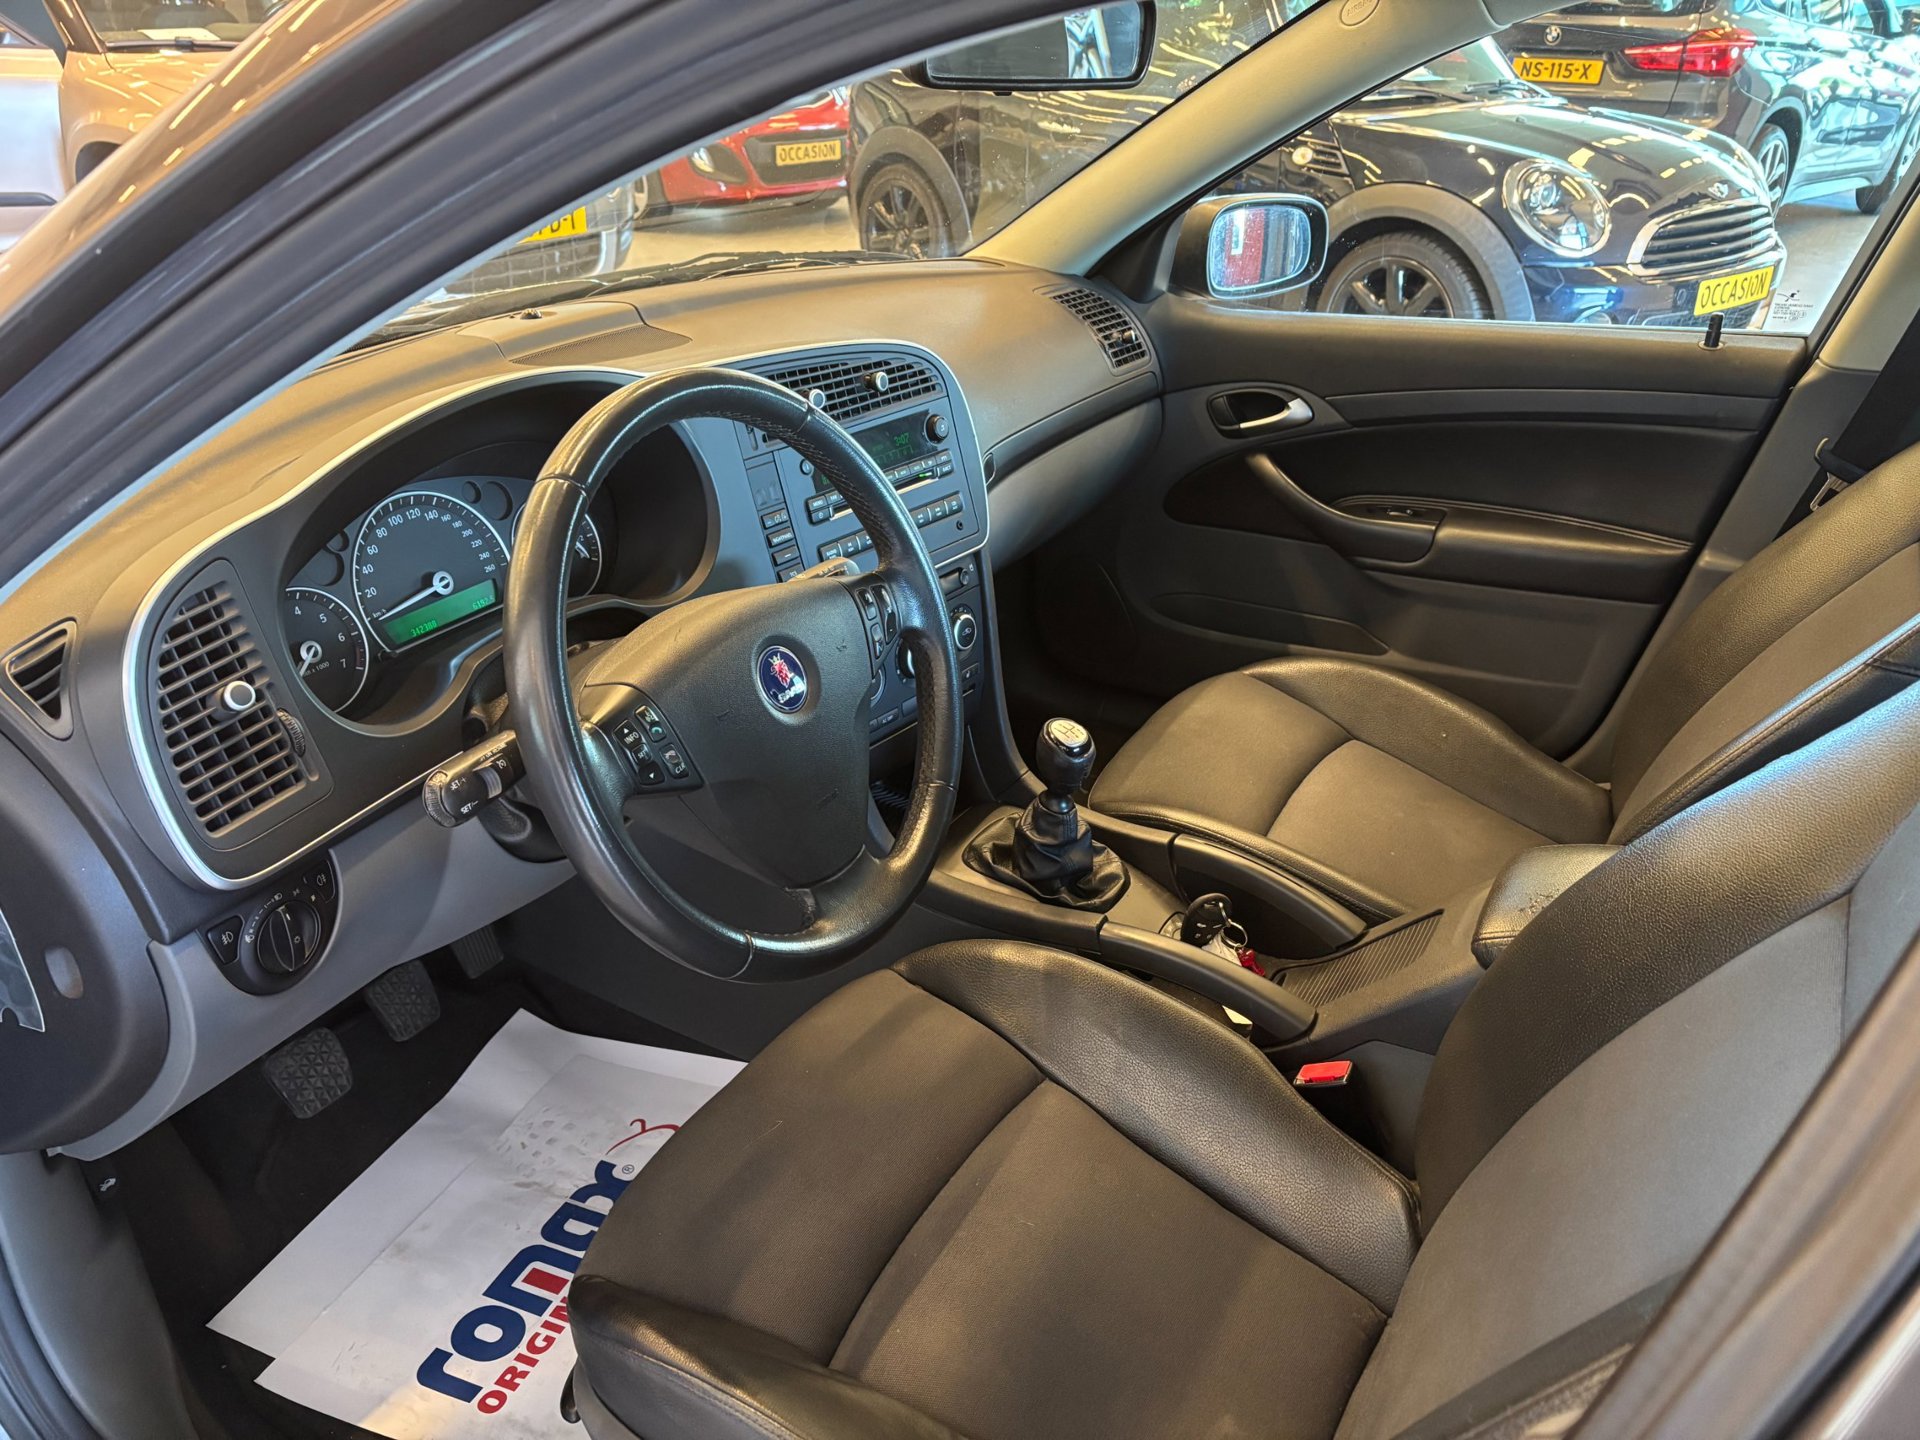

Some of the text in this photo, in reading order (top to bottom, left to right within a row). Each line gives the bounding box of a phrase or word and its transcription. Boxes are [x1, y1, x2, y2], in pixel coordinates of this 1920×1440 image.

[1520, 61, 1592, 80] NS-115-X
[779, 144, 837, 162] OCCASION
[1700, 271, 1769, 309] OCCASION
[406, 508, 421, 520] 120
[424, 510, 439, 521] 140
[441, 513, 451, 523] 160
[388, 514, 403, 526] 100
[452, 520, 462, 529] 180
[375, 527, 387, 538] 80
[462, 528, 473, 538] 200
[471, 539, 482, 548] 220
[367, 545, 379, 556] 60
[479, 551, 490, 560] 240
[362, 563, 374, 575] 40
[484, 563, 496, 573] 260
[364, 587, 377, 599] 20
[294, 606, 302, 616] 4
[319, 613, 328, 623] 5
[338, 632, 346, 642] 6
[340, 658, 348, 668] 7
[624, 732, 639, 744] INFO
